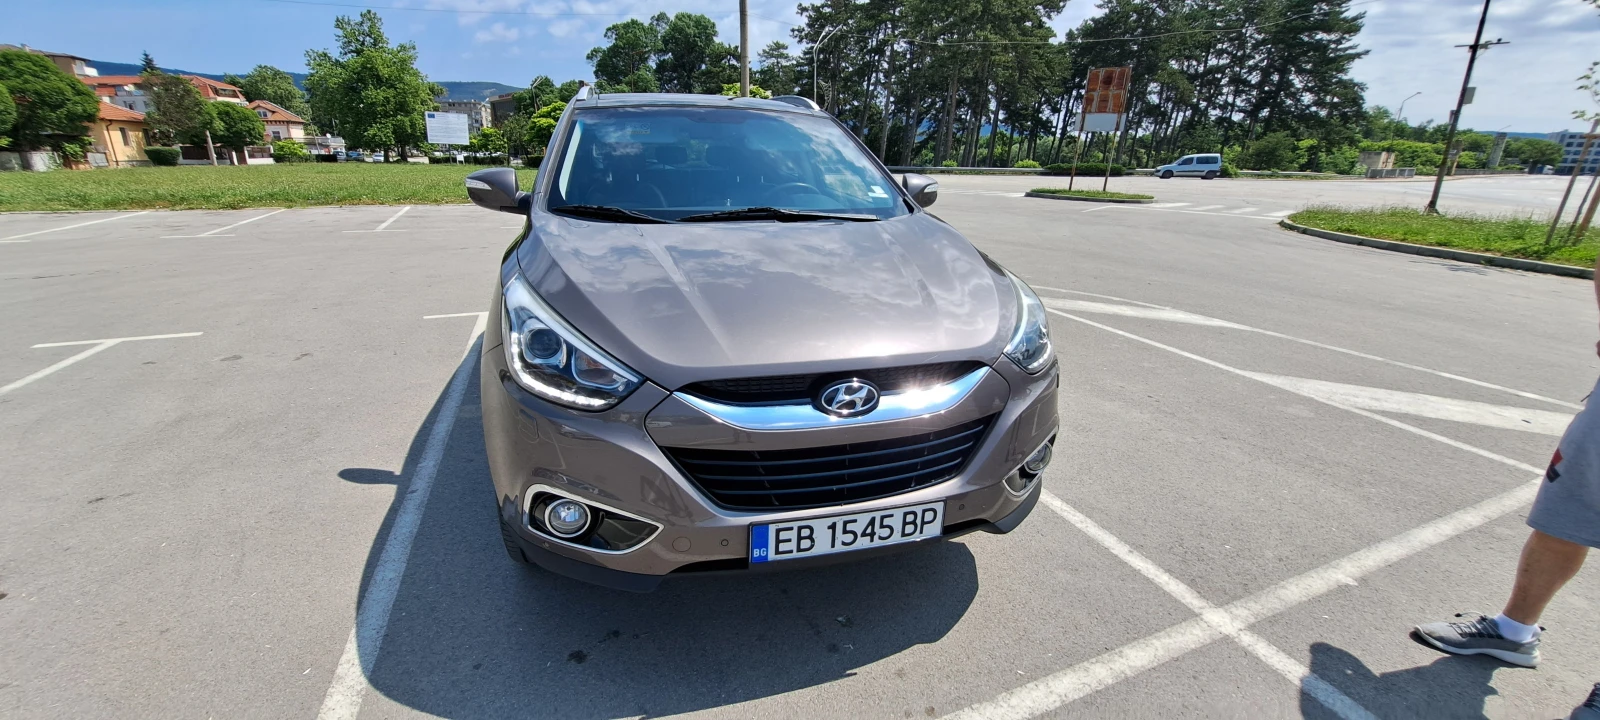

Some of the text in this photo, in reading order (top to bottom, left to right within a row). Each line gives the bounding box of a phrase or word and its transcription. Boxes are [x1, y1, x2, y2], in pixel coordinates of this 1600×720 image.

[774, 507, 938, 556] EB 1545 BP
[753, 548, 767, 557] BG
